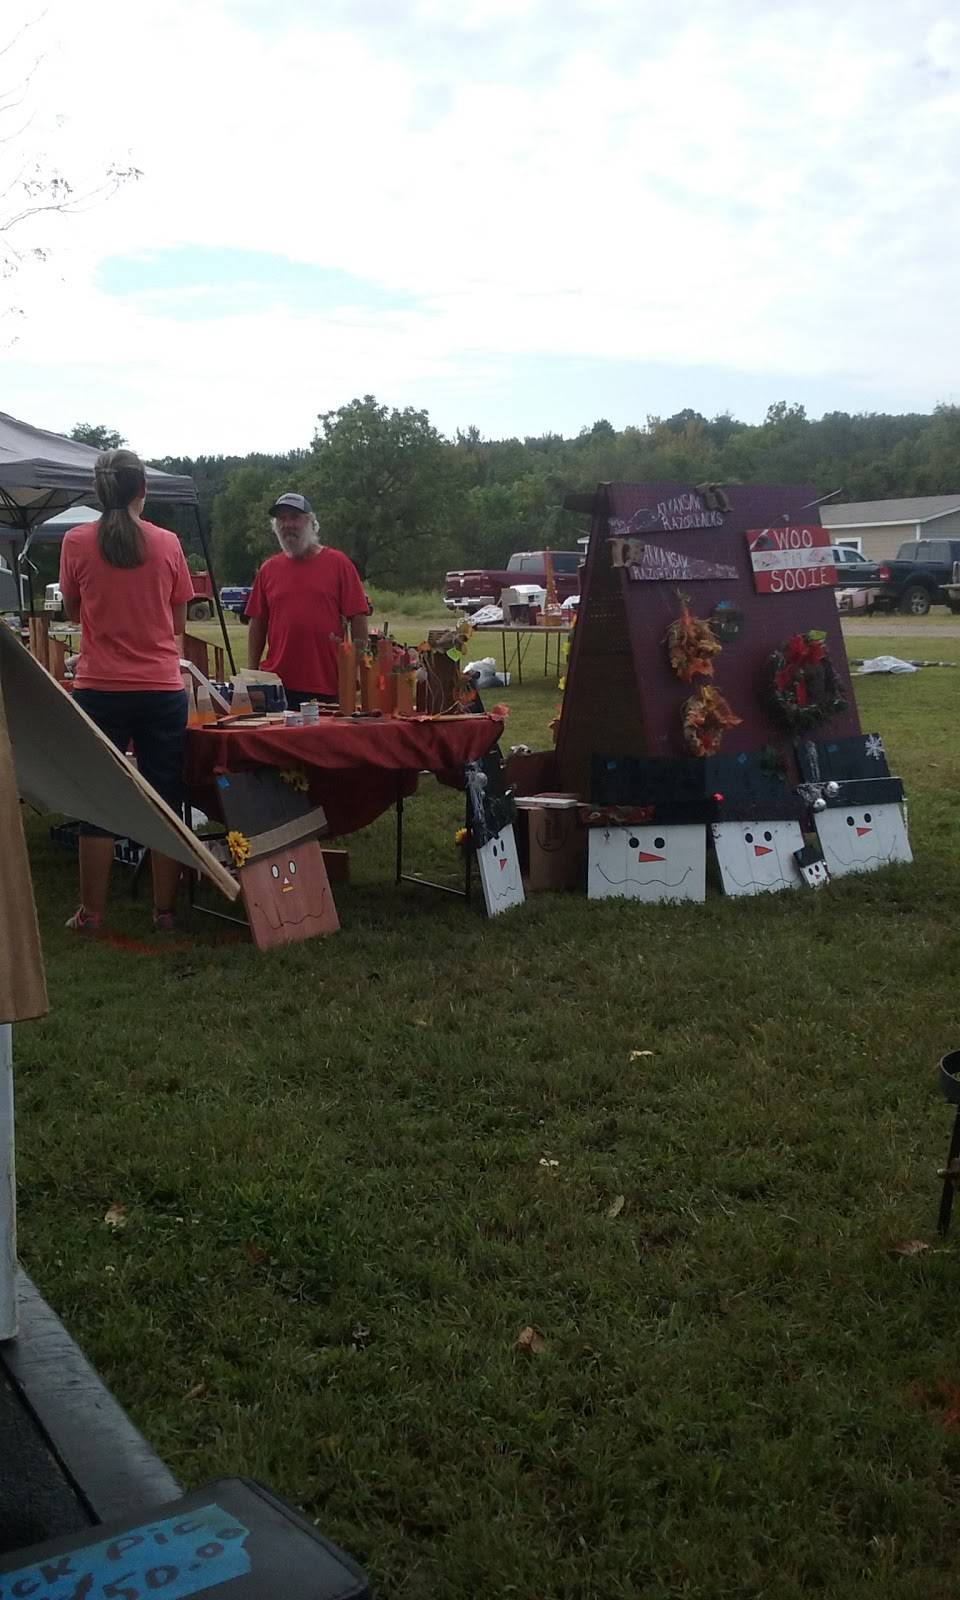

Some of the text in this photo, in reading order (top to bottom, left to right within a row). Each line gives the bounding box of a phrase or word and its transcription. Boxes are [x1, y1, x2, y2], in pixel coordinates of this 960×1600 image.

[773, 527, 812, 550] WOO
[770, 566, 830, 593] SOOIE
[0, 1556, 77, 1598] CK
